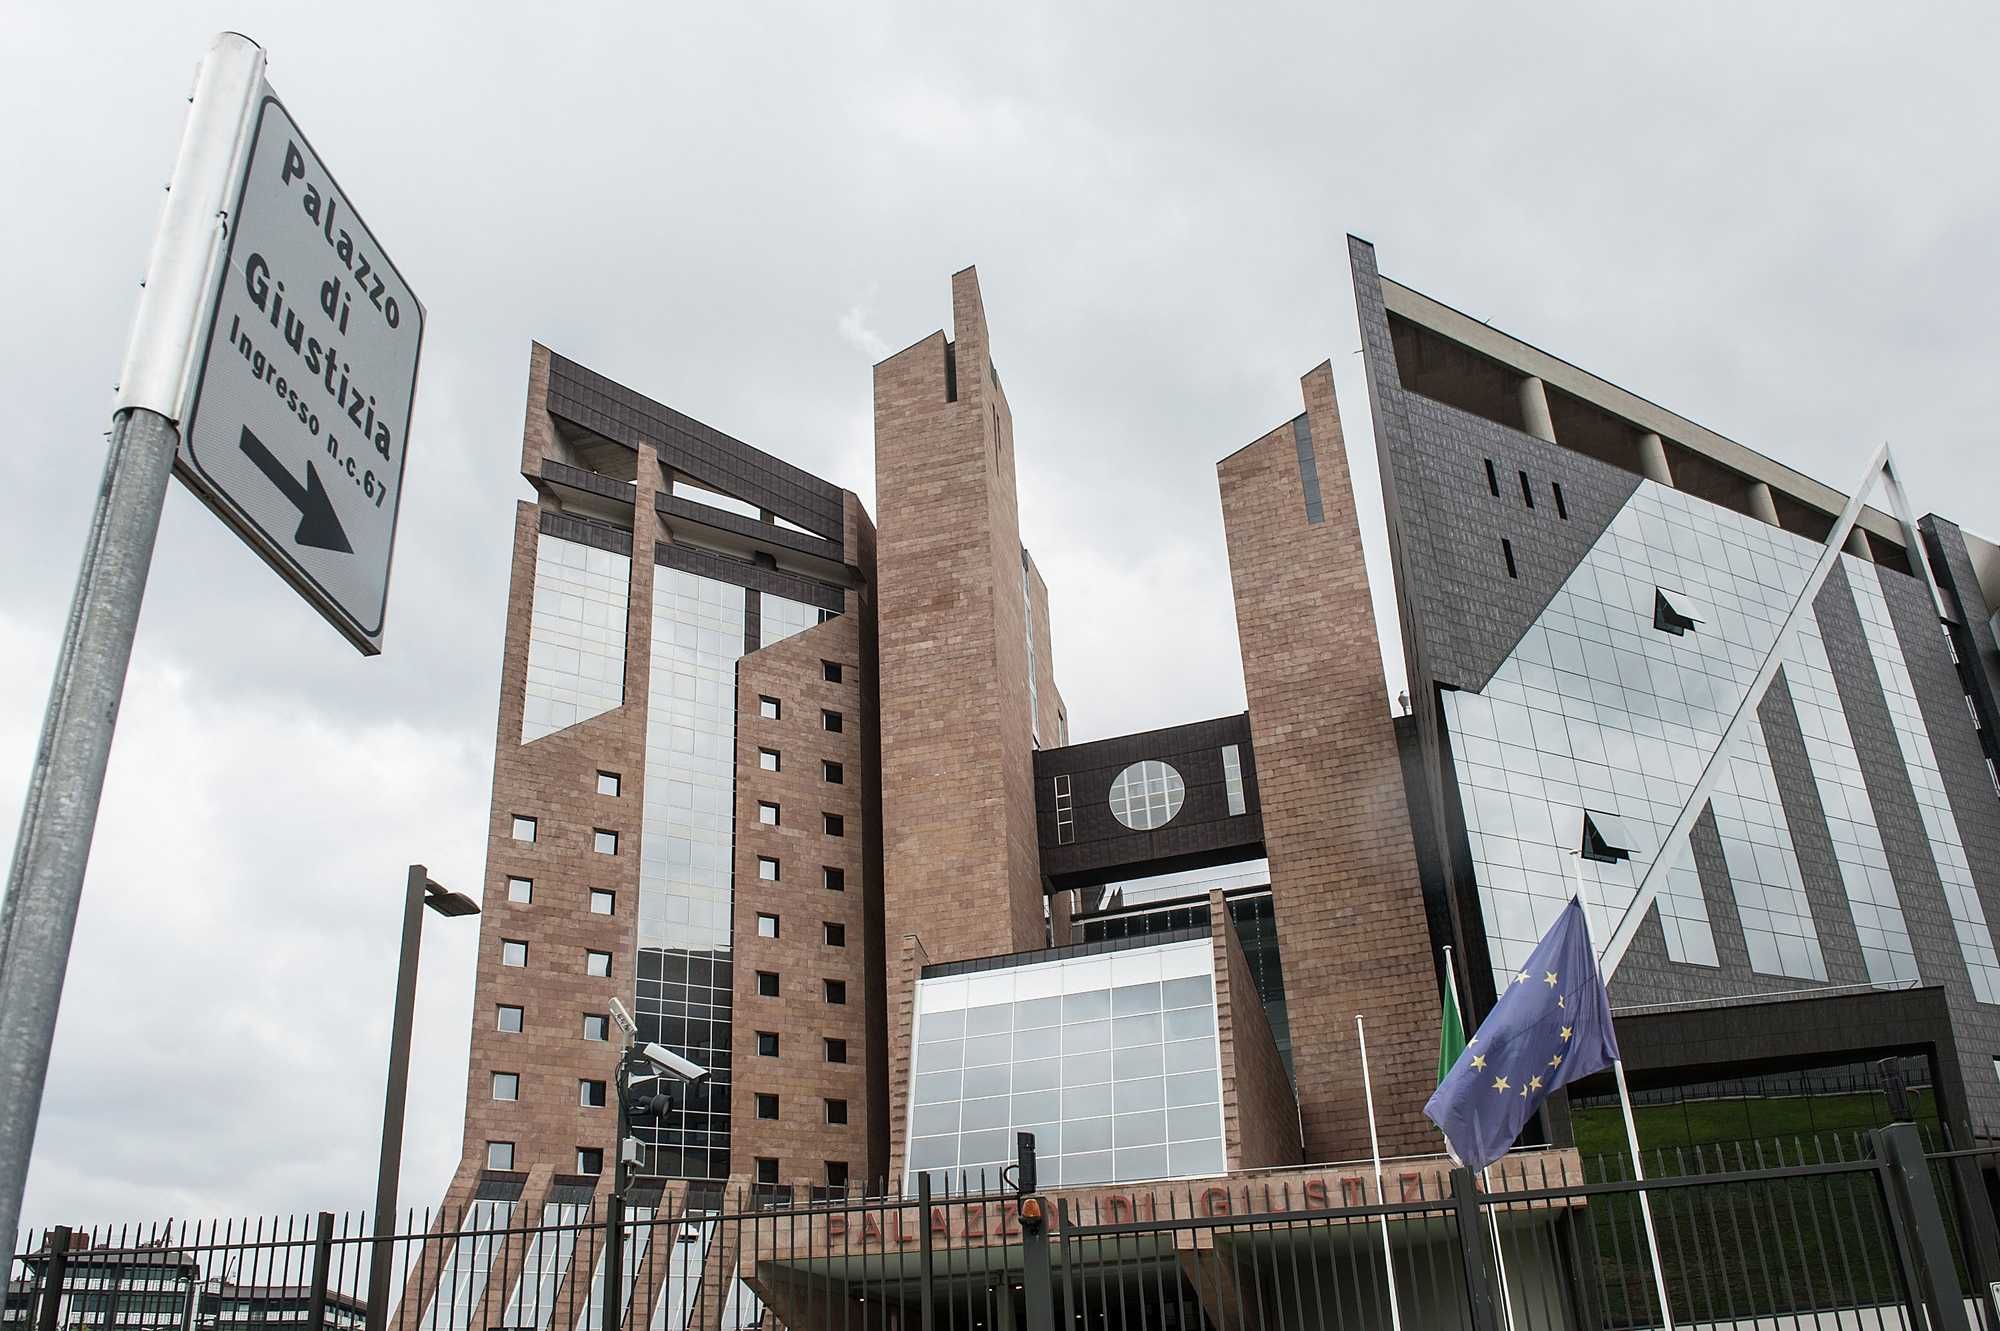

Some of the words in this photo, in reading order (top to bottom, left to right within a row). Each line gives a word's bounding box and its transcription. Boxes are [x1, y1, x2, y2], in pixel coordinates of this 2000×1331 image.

[281, 139, 400, 329] Palazzo
[320, 275, 352, 337] di
[229, 314, 320, 436] Ingresso
[245, 252, 391, 463] Giustizia
